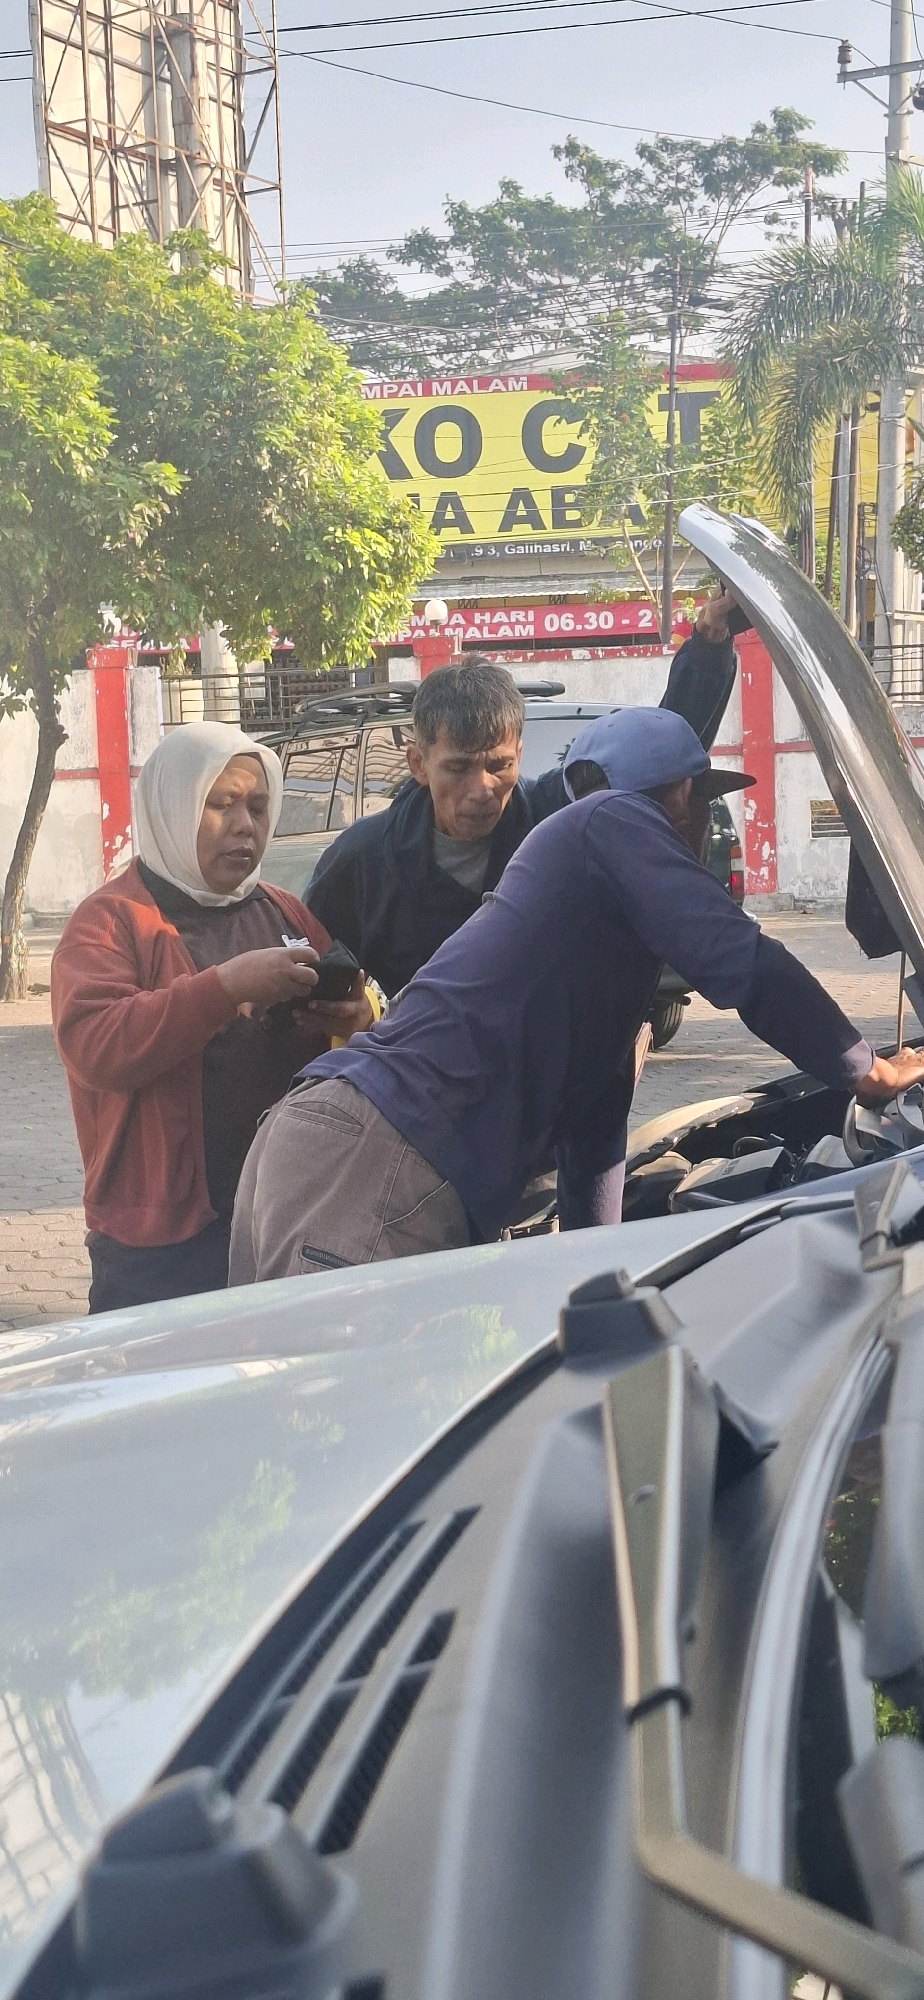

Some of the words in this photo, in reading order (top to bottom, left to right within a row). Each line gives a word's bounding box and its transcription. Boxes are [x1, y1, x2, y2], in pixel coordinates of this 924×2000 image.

[432, 376, 528, 396] MALAM
[521, 390, 722, 474] CT
[474, 610, 535, 624] HARI
[544, 611, 614, 632] 06.30
